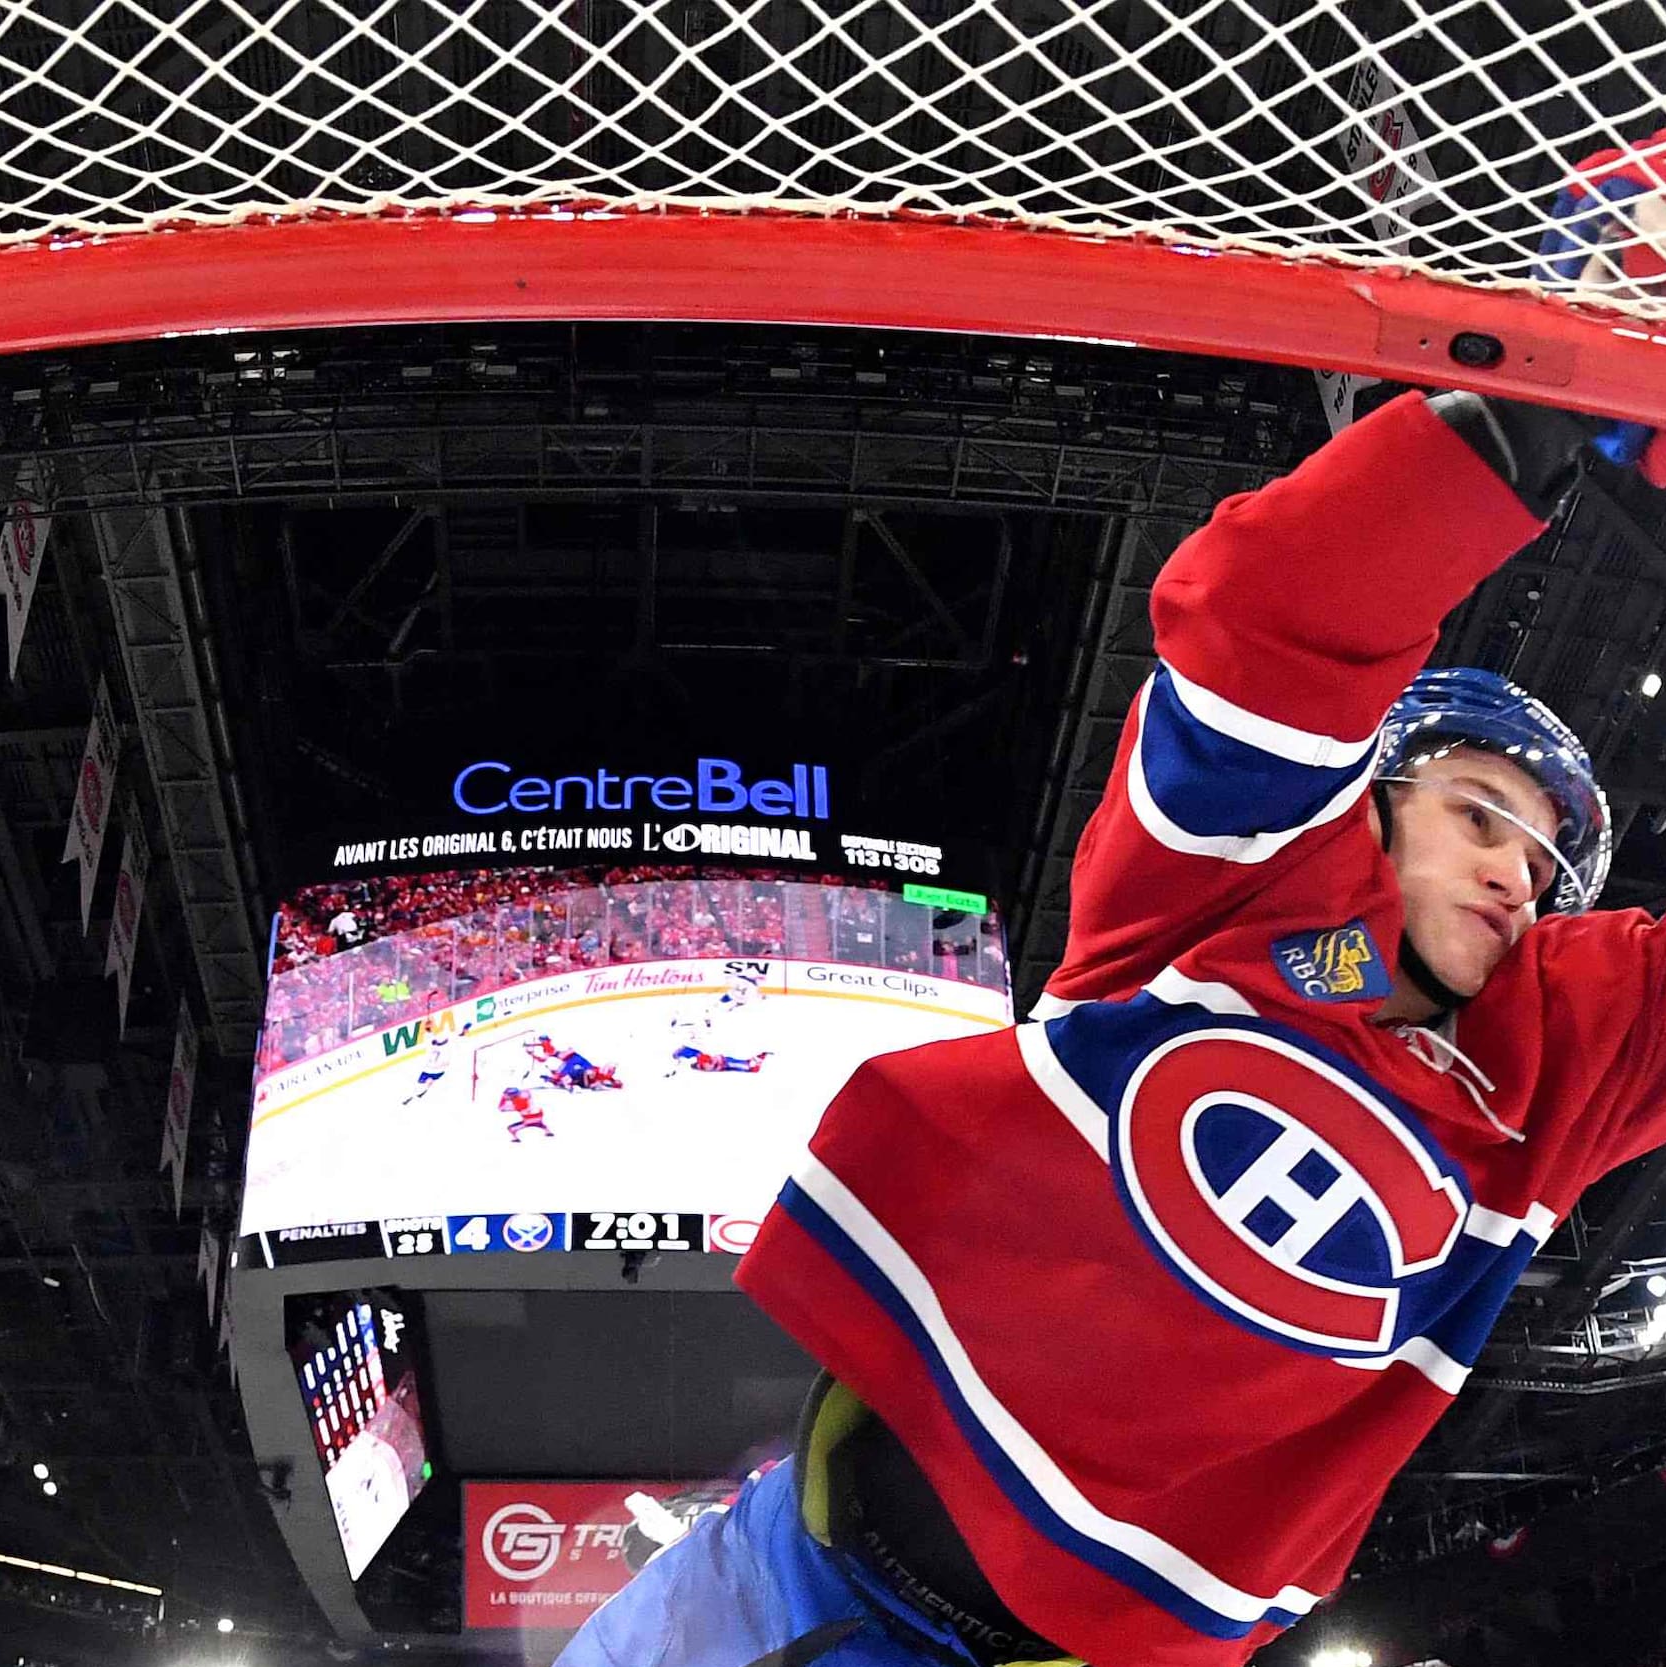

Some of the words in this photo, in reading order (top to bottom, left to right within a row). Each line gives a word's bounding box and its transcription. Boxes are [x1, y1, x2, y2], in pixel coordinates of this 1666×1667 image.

[334, 838, 387, 867] AVANT
[389, 836, 419, 860] LES
[421, 832, 498, 856] ORIGINAL
[520, 825, 583, 852] C'ÉTAIT
[586, 827, 632, 849] NOUS
[844, 848, 880, 867] 113
[583, 970, 621, 995] Tim
[623, 963, 705, 990] Hortons
[806, 965, 875, 988] Great
[882, 973, 939, 999] Clips
[1281, 947, 1328, 996] RBC
[278, 1219, 368, 1242] PENALTIES
[454, 1216, 491, 1251] 4
[589, 1212, 689, 1241] 7:01
[396, 1233, 434, 1255] 25
[489, 1592, 508, 1605] LA
[509, 1591, 573, 1605] BOUTIQUE
